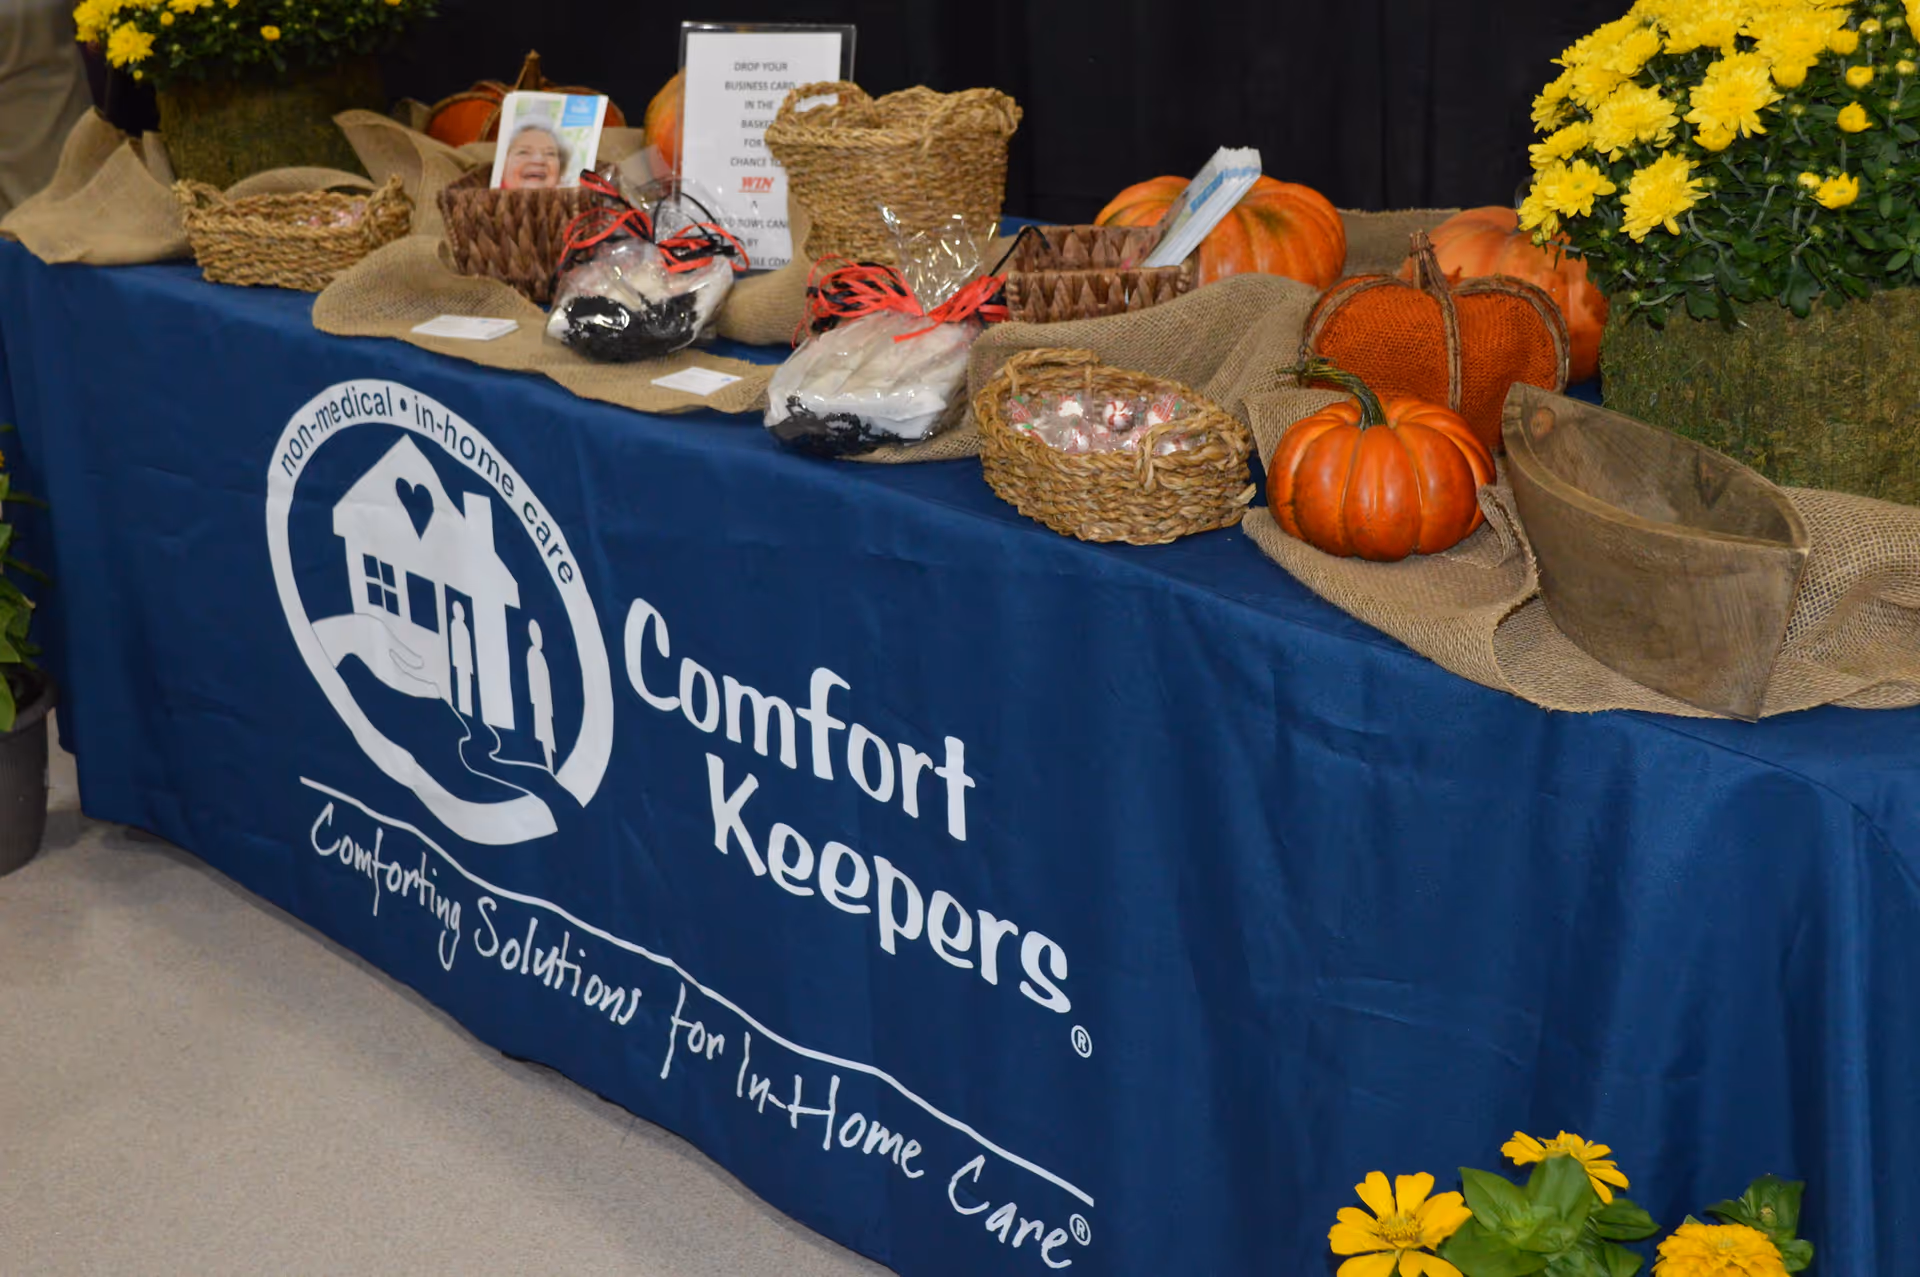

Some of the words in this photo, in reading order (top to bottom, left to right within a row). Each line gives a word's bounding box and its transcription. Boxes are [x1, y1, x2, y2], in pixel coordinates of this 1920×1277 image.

[734, 62, 759, 71] DROP
[763, 62, 788, 71] YOUR
[725, 81, 768, 91] BUSINESS
[770, 81, 796, 91] CARD
[744, 100, 755, 110] IN
[757, 100, 774, 110] THE
[744, 138, 762, 148] FOR
[730, 157, 767, 167] CHANCE
[741, 176, 774, 190] WIN
[766, 219, 788, 229] CAN
[768, 257, 791, 267] COM
[280, 386, 394, 477] non-medical
[414, 394, 515, 498] in-home
[522, 501, 573, 585] care
[624, 597, 976, 841] Comfort
[705, 752, 1072, 1014] Keepers
[310, 801, 462, 971] Comforting
[474, 896, 643, 1025] Solutions
[660, 982, 725, 1080] for
[736, 1031, 924, 1179] In-Home
